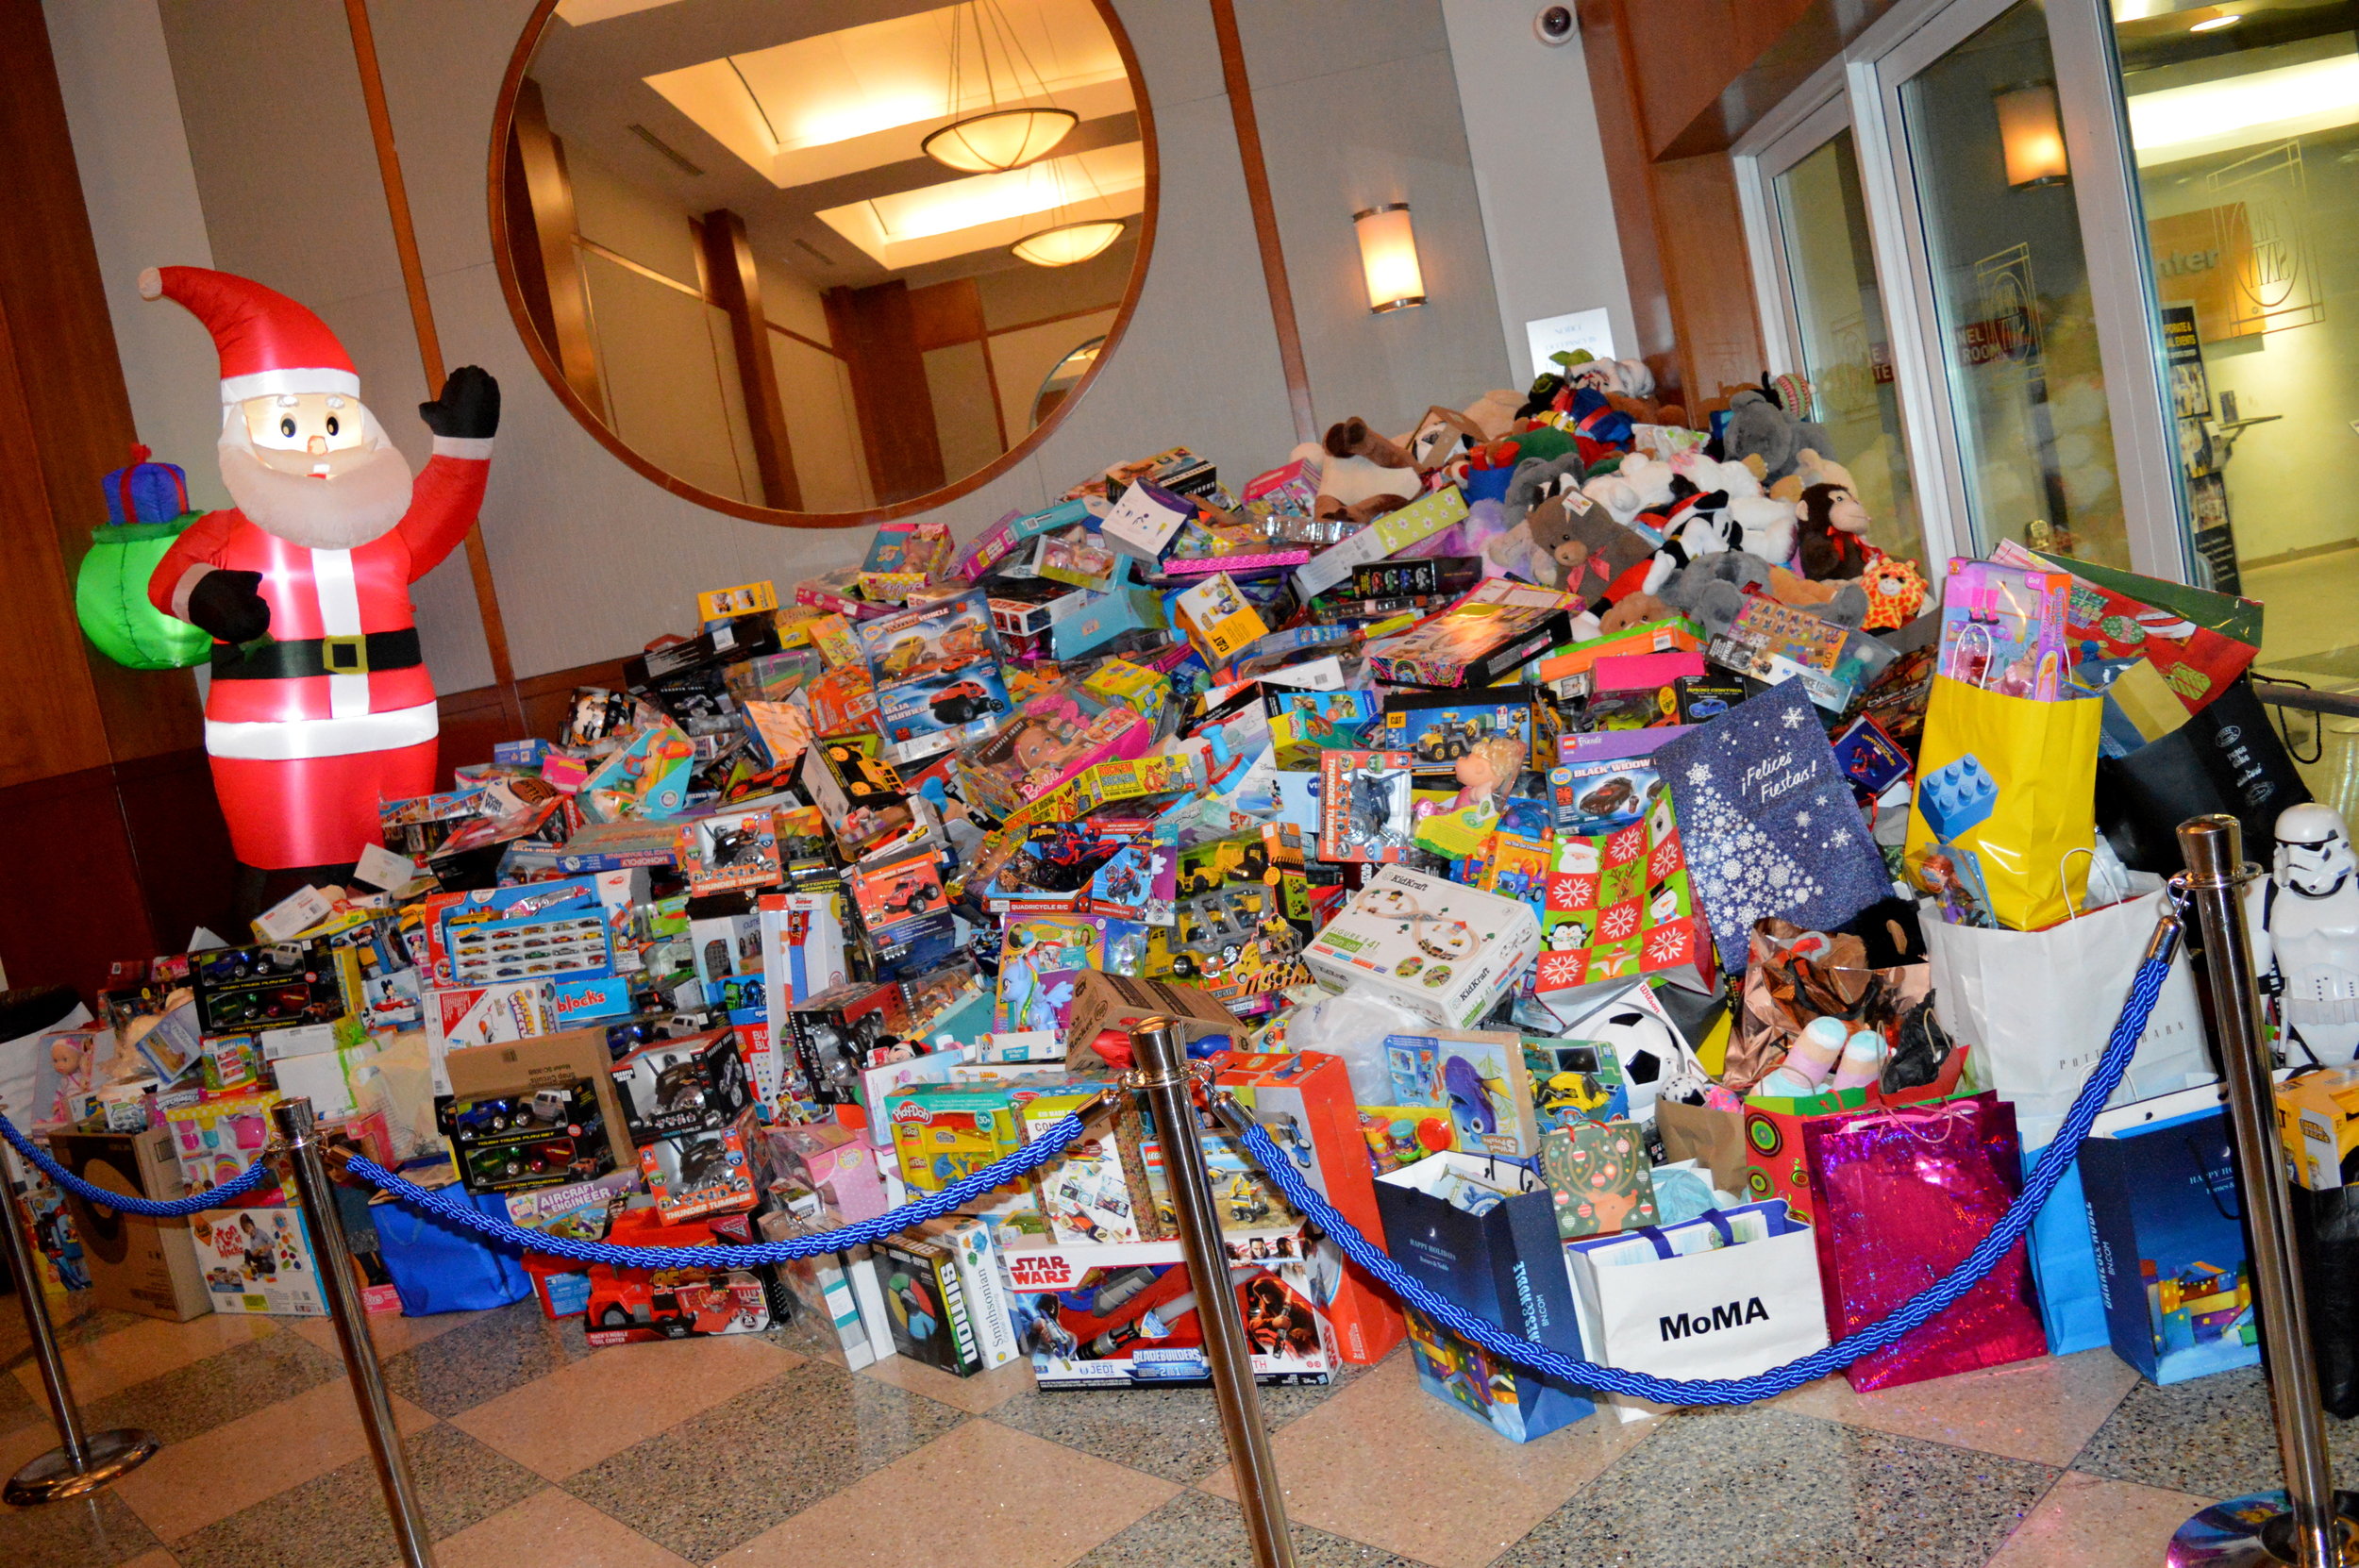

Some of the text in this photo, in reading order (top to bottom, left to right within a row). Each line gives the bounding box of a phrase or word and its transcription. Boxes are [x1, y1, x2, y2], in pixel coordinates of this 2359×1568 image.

[1213, 635, 1230, 652] CAT
[884, 703, 929, 723] BAJA RUNNER
[1390, 716, 1402, 725] CAT
[1578, 736, 1602, 746] Friends
[1574, 759, 1650, 778] BLACK WIDOW
[1020, 770, 1065, 802] Barbie
[1762, 759, 1816, 803] Fiestas!
[1326, 759, 1336, 856] THUNDER TUMBLER
[621, 857, 668, 867] MONOPOLY
[696, 879, 736, 892] THUNDER
[738, 873, 778, 885] TUMBLER
[1391, 874, 1429, 892] KidKraft
[1321, 933, 1346, 947] train
[1330, 926, 1362, 941] FIGURE
[1459, 966, 1491, 1002] KidKraft
[557, 989, 606, 1013] blocks
[1639, 984, 1661, 1014] Wilson
[892, 1103, 930, 1123] Play-Doh
[977, 1114, 991, 1126] 30+
[1146, 1151, 1163, 1160] LEGO
[527, 1177, 565, 1188] POWERED
[540, 1182, 596, 1209] AIRCRAFT
[552, 1187, 611, 1213] ENGINEER
[665, 1193, 752, 1220] THUNDER TUMBLER
[216, 1225, 238, 1246] ton
[217, 1243, 245, 1259] blocks
[1409, 1238, 1457, 1261] HAPPY HOLIDAYS
[2102, 1241, 2116, 1276] BN.COM
[1011, 1256, 1071, 1271] STAR
[1011, 1270, 1071, 1285] WARS
[940, 1262, 979, 1365] simon
[978, 1267, 1005, 1348] Smithsonian
[1536, 1293, 1550, 1327] BN.COM
[1659, 1296, 1770, 1343] MoMA
[1132, 1348, 1203, 1364] BLADEBUILDERS
[1090, 1364, 1115, 1375] JEDI
